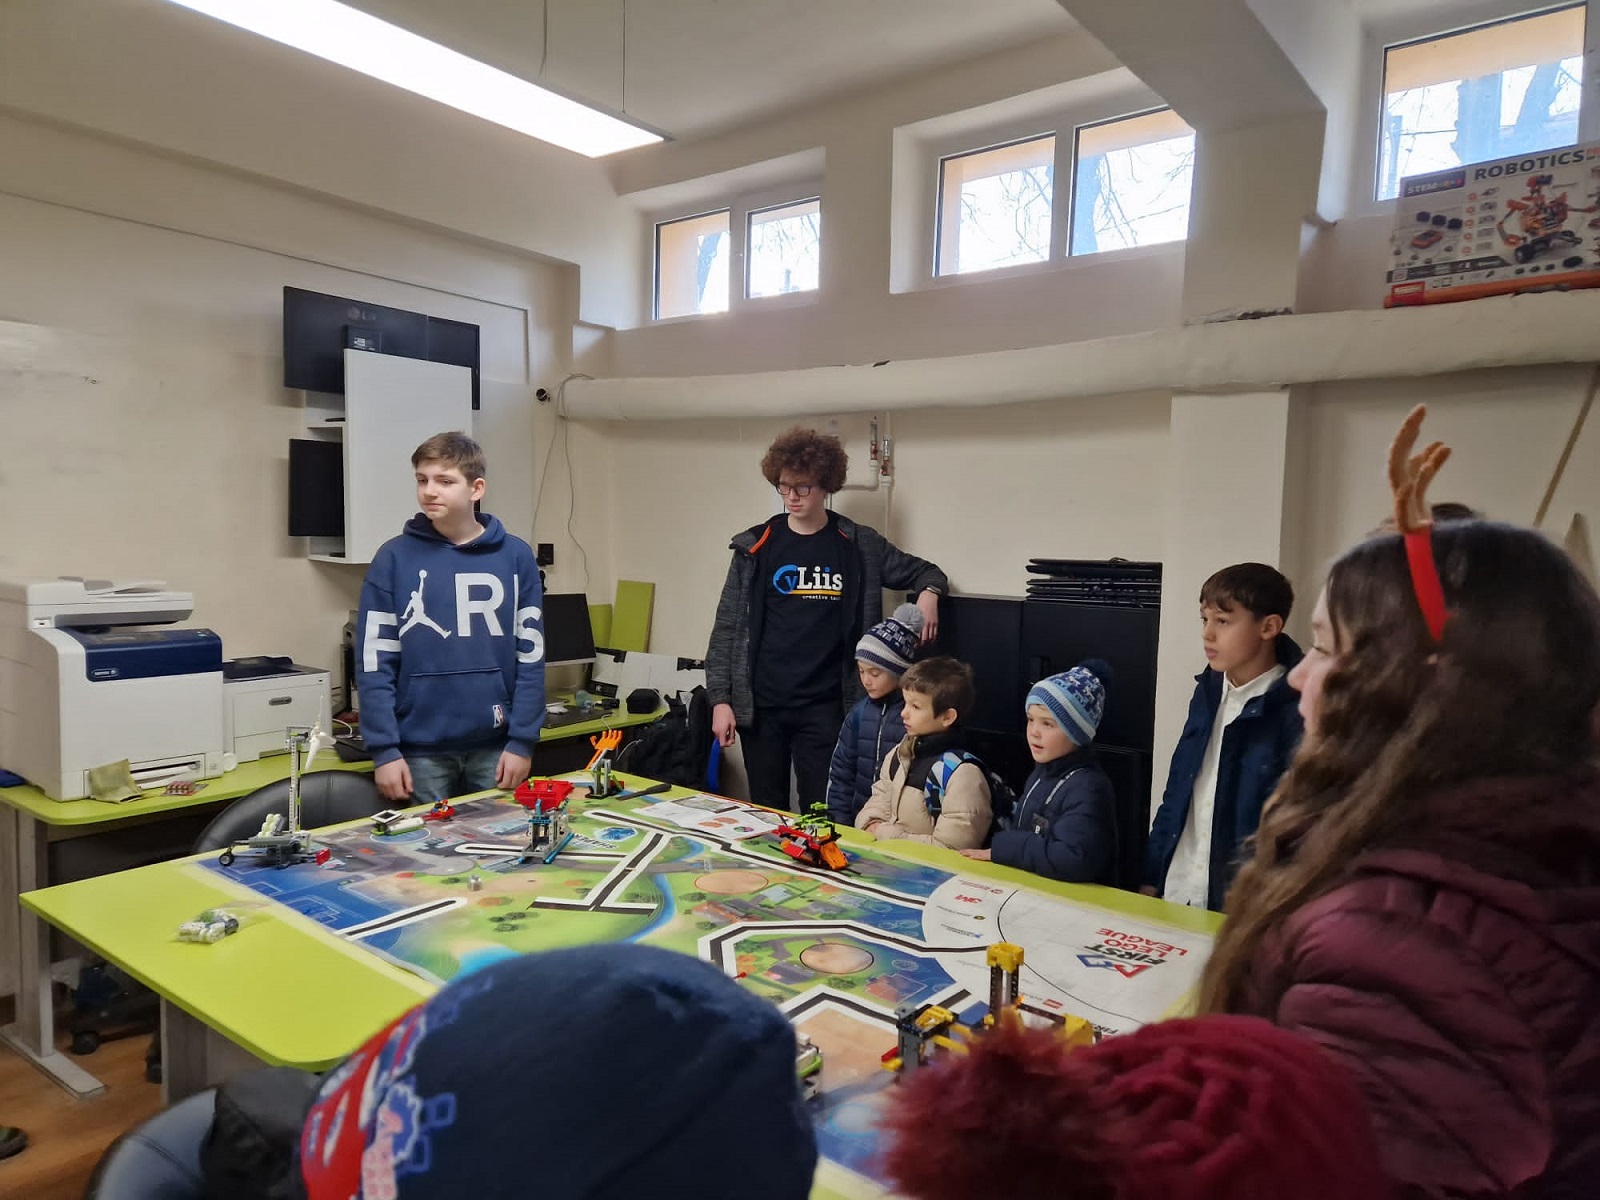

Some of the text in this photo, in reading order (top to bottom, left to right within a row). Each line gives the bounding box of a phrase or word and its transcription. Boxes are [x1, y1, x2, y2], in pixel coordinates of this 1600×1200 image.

[1474, 150, 1585, 180] ROBOTICS
[954, 894, 982, 904] 3M
[1095, 927, 1188, 957] LEAGUE
[1104, 938, 1167, 958] LEGO
[1083, 944, 1167, 966] FIRST
